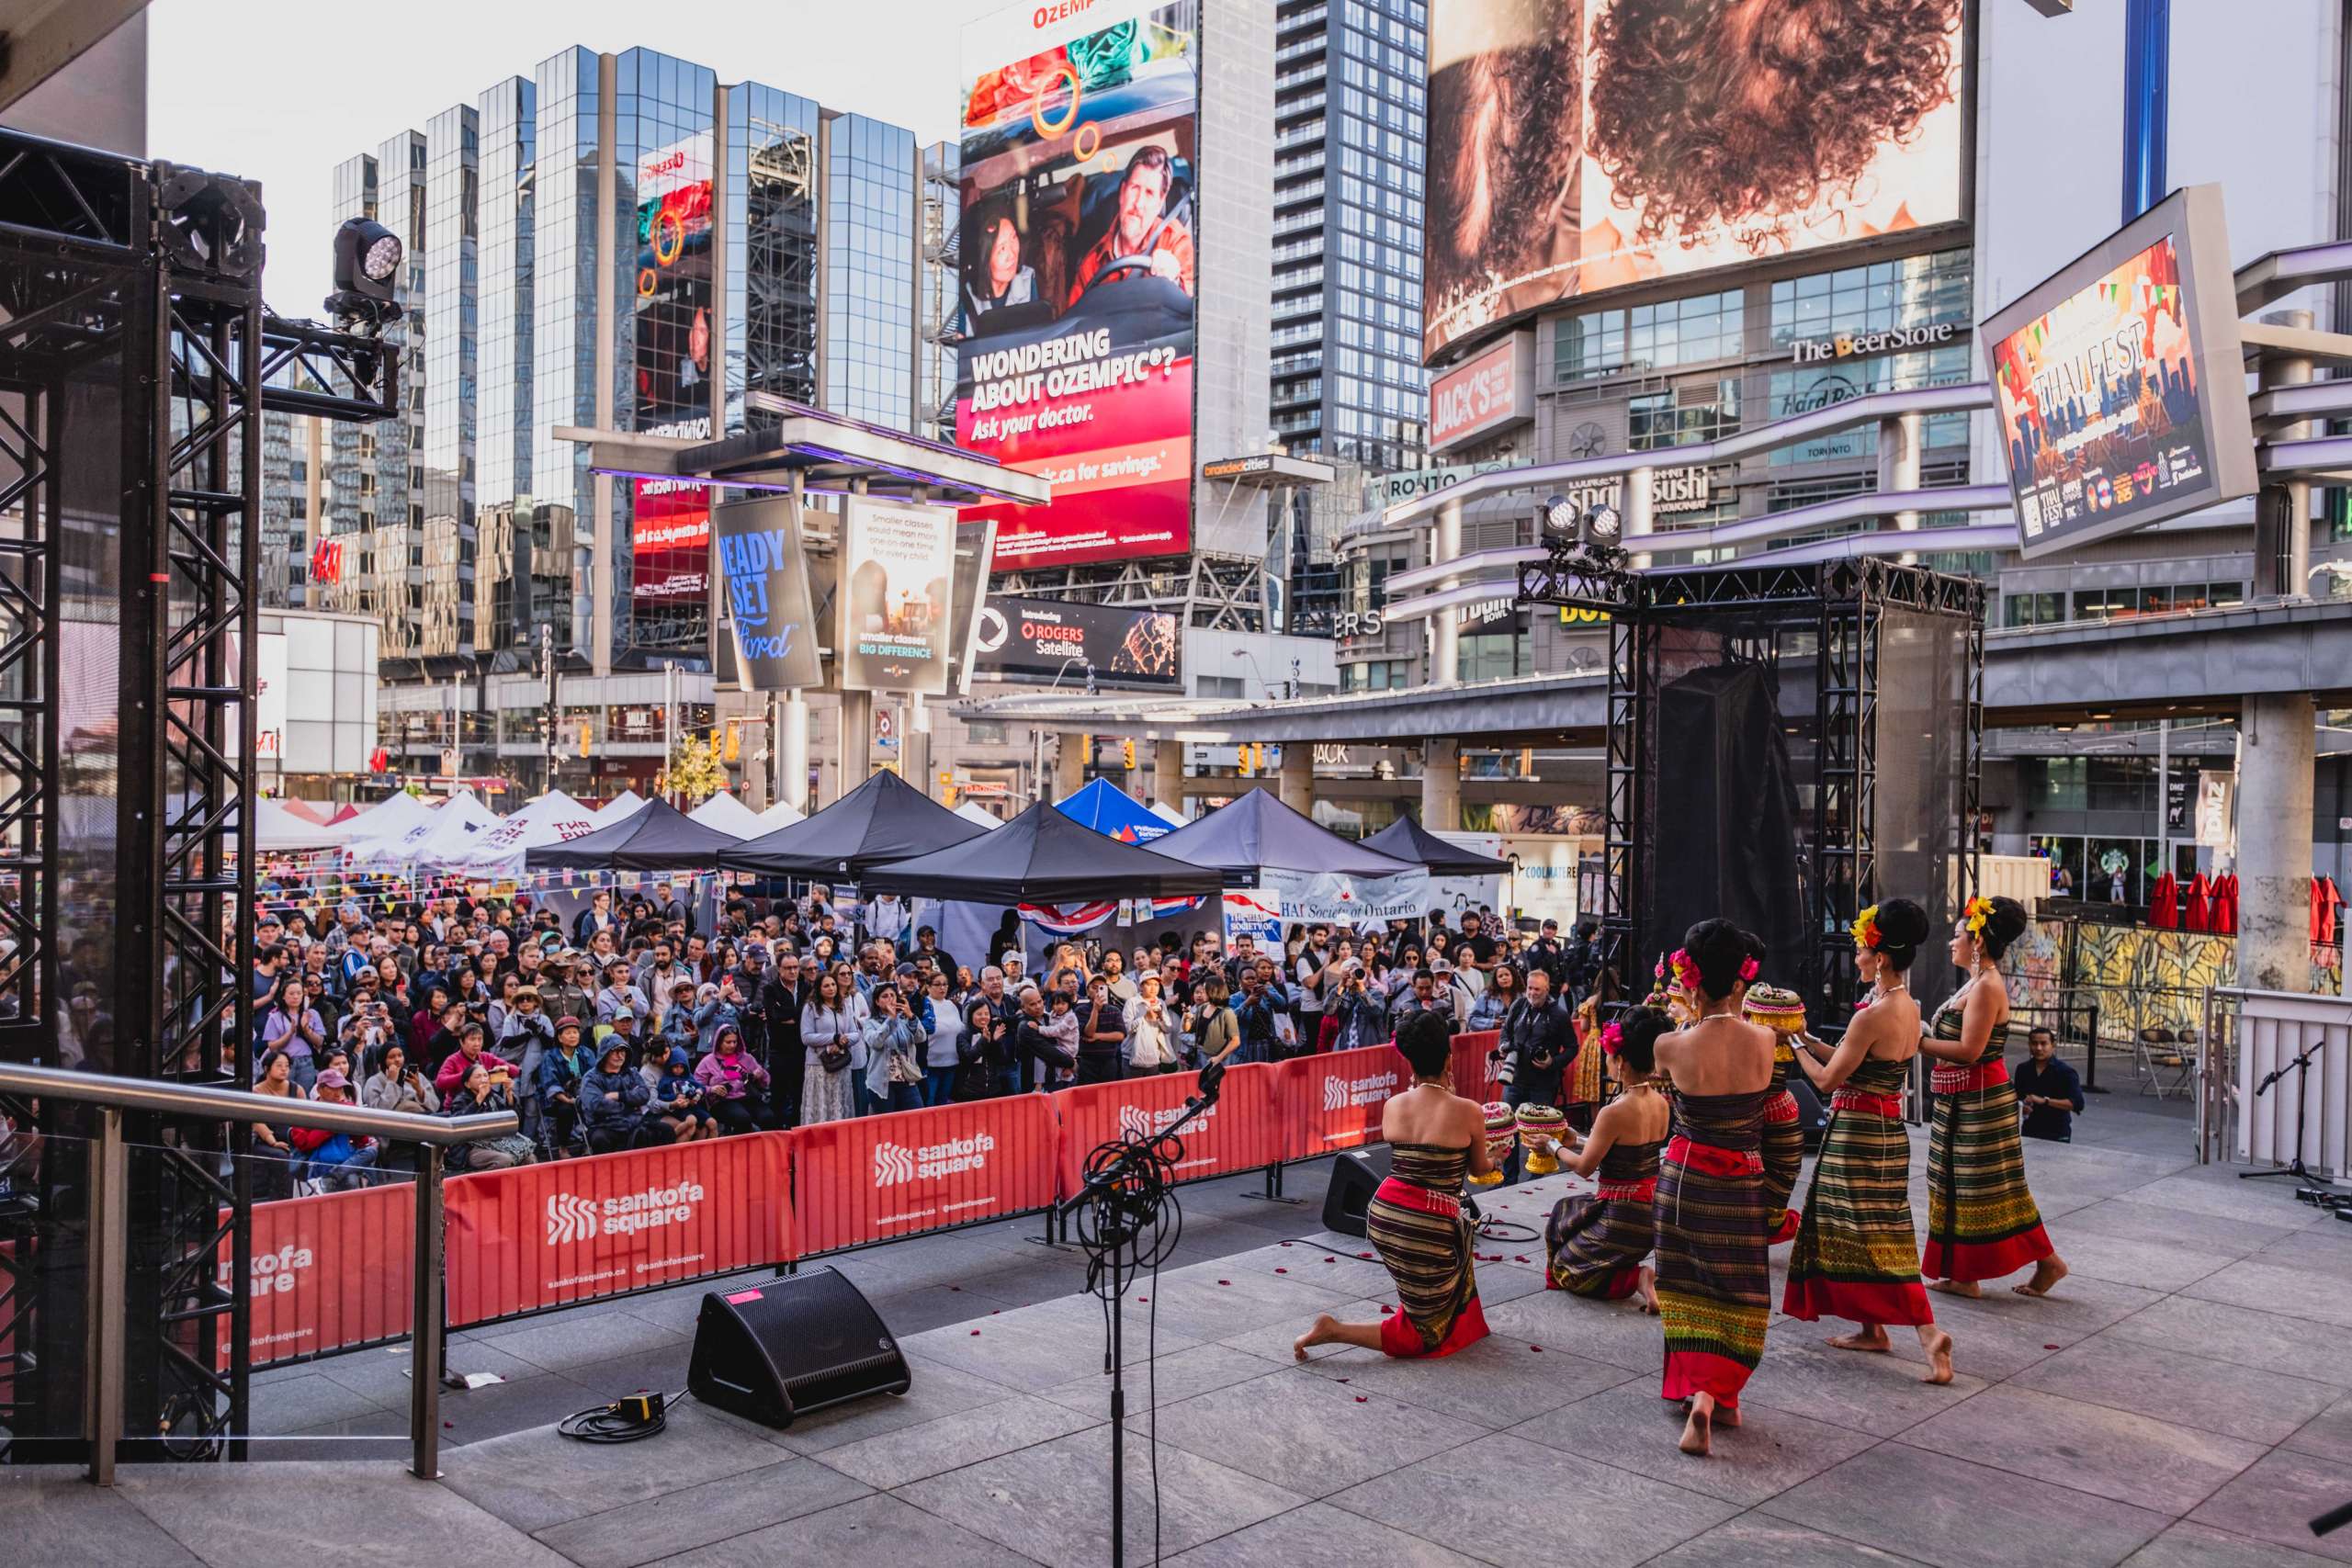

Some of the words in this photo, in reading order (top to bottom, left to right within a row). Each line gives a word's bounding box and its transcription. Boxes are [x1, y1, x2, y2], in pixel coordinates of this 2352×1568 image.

[971, 328, 1110, 382] WONDERING
[1789, 340, 1834, 364] The
[1834, 333, 1891, 358] Beer
[1890, 321, 1952, 348] Store
[2087, 321, 2146, 404] FEST
[970, 373, 1044, 412] ABOUT
[1431, 370, 1490, 436] JACK'S
[971, 416, 999, 441] Ask
[999, 414, 1037, 442] your
[1037, 404, 1094, 430] doctor.
[1808, 444, 1851, 457] TORONTO
[1078, 462, 1100, 481] for
[1653, 466, 1709, 502] sushi
[731, 572, 769, 616] SET
[1483, 610, 1508, 625] BOWL
[1036, 626, 1084, 642] ROGERS
[1036, 638, 1084, 658] Satellite
[859, 644, 876, 654] BIG
[877, 644, 933, 660] DIFFERENCE
[1364, 899, 1417, 919] Ontario
[1351, 1071, 1397, 1093] sankofa
[1351, 1088, 1391, 1108] square
[917, 1132, 995, 1163] sankofa
[917, 1153, 985, 1180] square
[603, 1180, 705, 1216] sankofa
[603, 1204, 691, 1235] square
[548, 1267, 627, 1290] sankofasquare.ca
[636, 1252, 706, 1274] @sankofasquare
